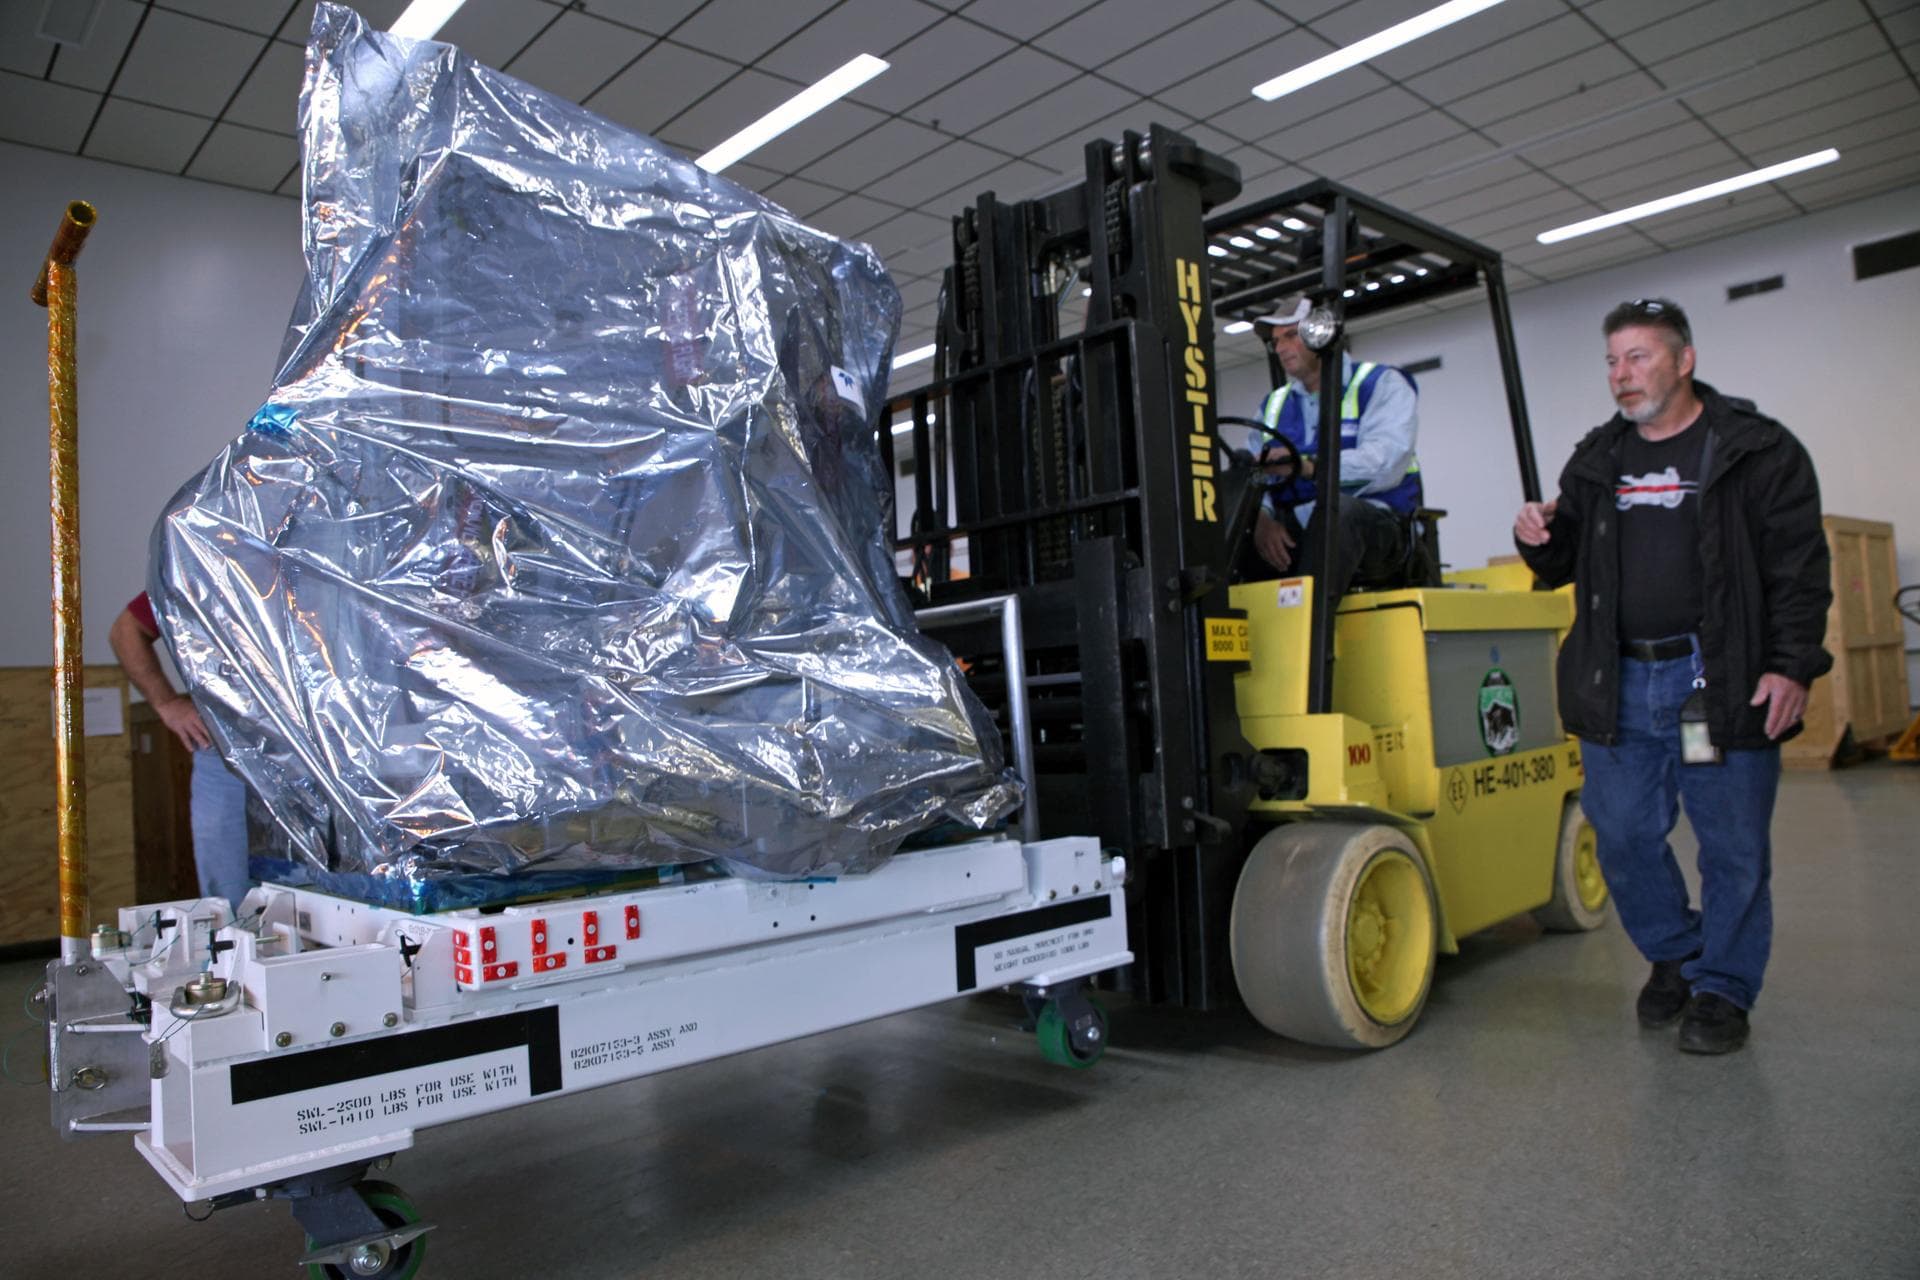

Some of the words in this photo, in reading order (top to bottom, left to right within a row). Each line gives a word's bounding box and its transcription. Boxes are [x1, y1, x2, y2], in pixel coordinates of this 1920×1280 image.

[1176, 258, 1217, 522] HYSTER
[1348, 743, 1371, 766] 100
[1473, 754, 1556, 798] HE-401-380
[647, 1027, 672, 1042] ASSY
[679, 1022, 698, 1034] AND
[652, 1038, 676, 1052] ASSY
[297, 1096, 372, 1121] SWL-2500
[381, 1088, 406, 1103] LBS
[416, 1080, 442, 1095] FOR
[450, 1073, 474, 1087] USE
[483, 1064, 514, 1079] WITH
[299, 1108, 374, 1134] SWL-1410
[384, 1101, 408, 1115] LBS
[417, 1093, 443, 1108] FOR
[452, 1085, 476, 1099] USE
[485, 1076, 517, 1092] WITH
